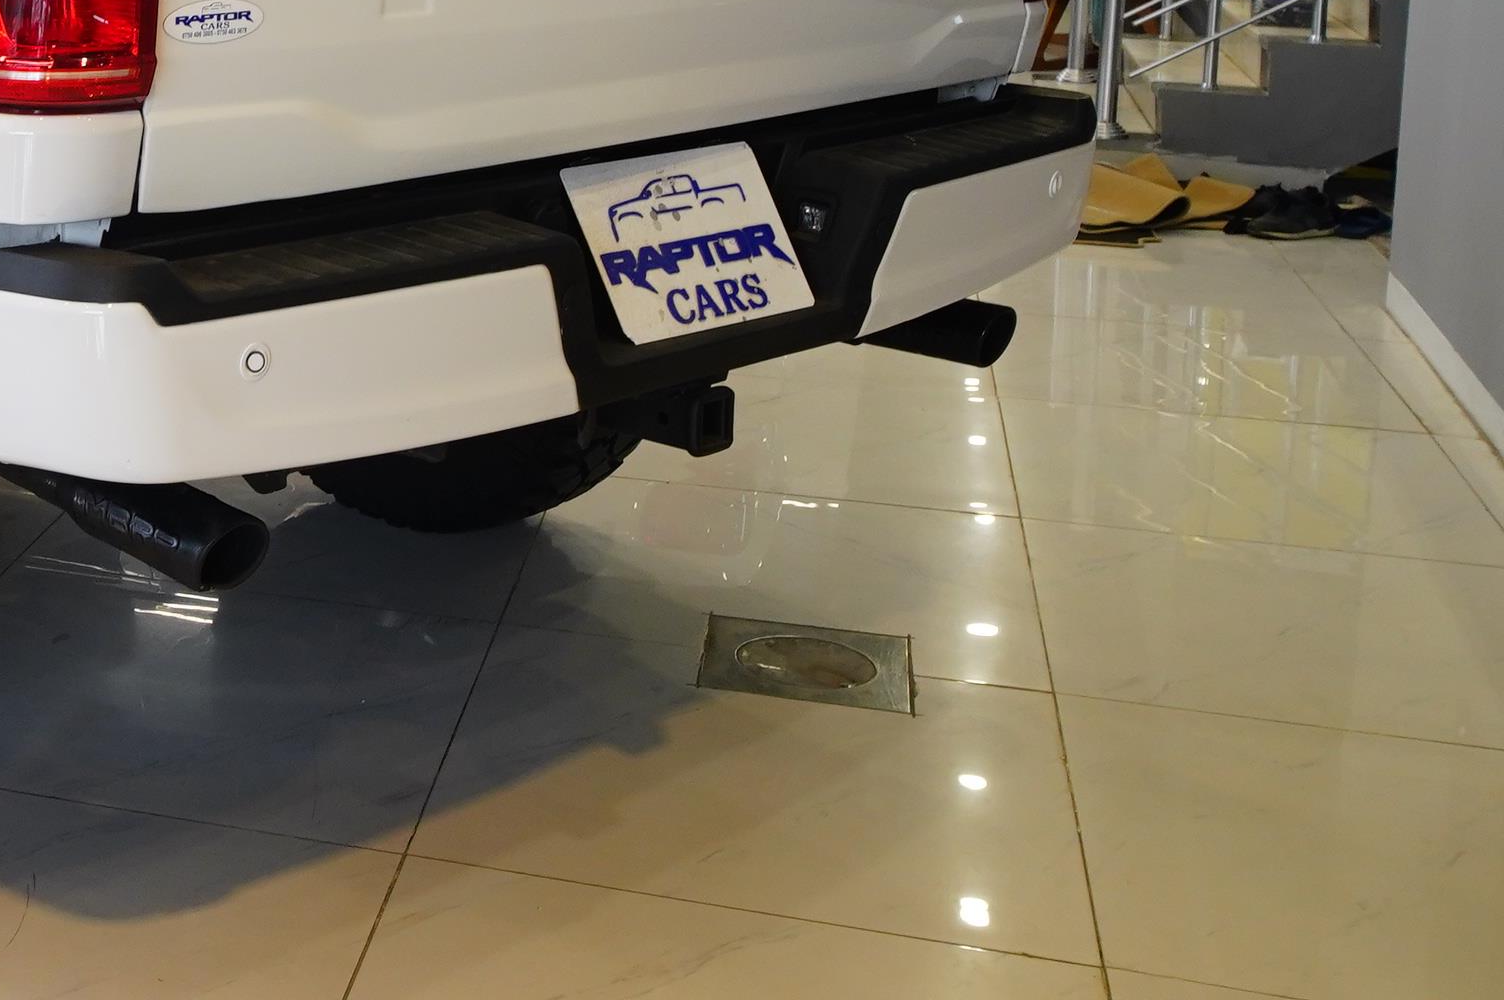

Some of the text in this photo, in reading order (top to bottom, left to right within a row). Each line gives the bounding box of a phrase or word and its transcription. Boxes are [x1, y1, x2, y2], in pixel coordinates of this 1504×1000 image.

[175, 10, 253, 27] RAPTOR
[200, 21, 230, 31] CARS
[600, 223, 795, 294] RAPTOR
[666, 273, 769, 325] CARS
